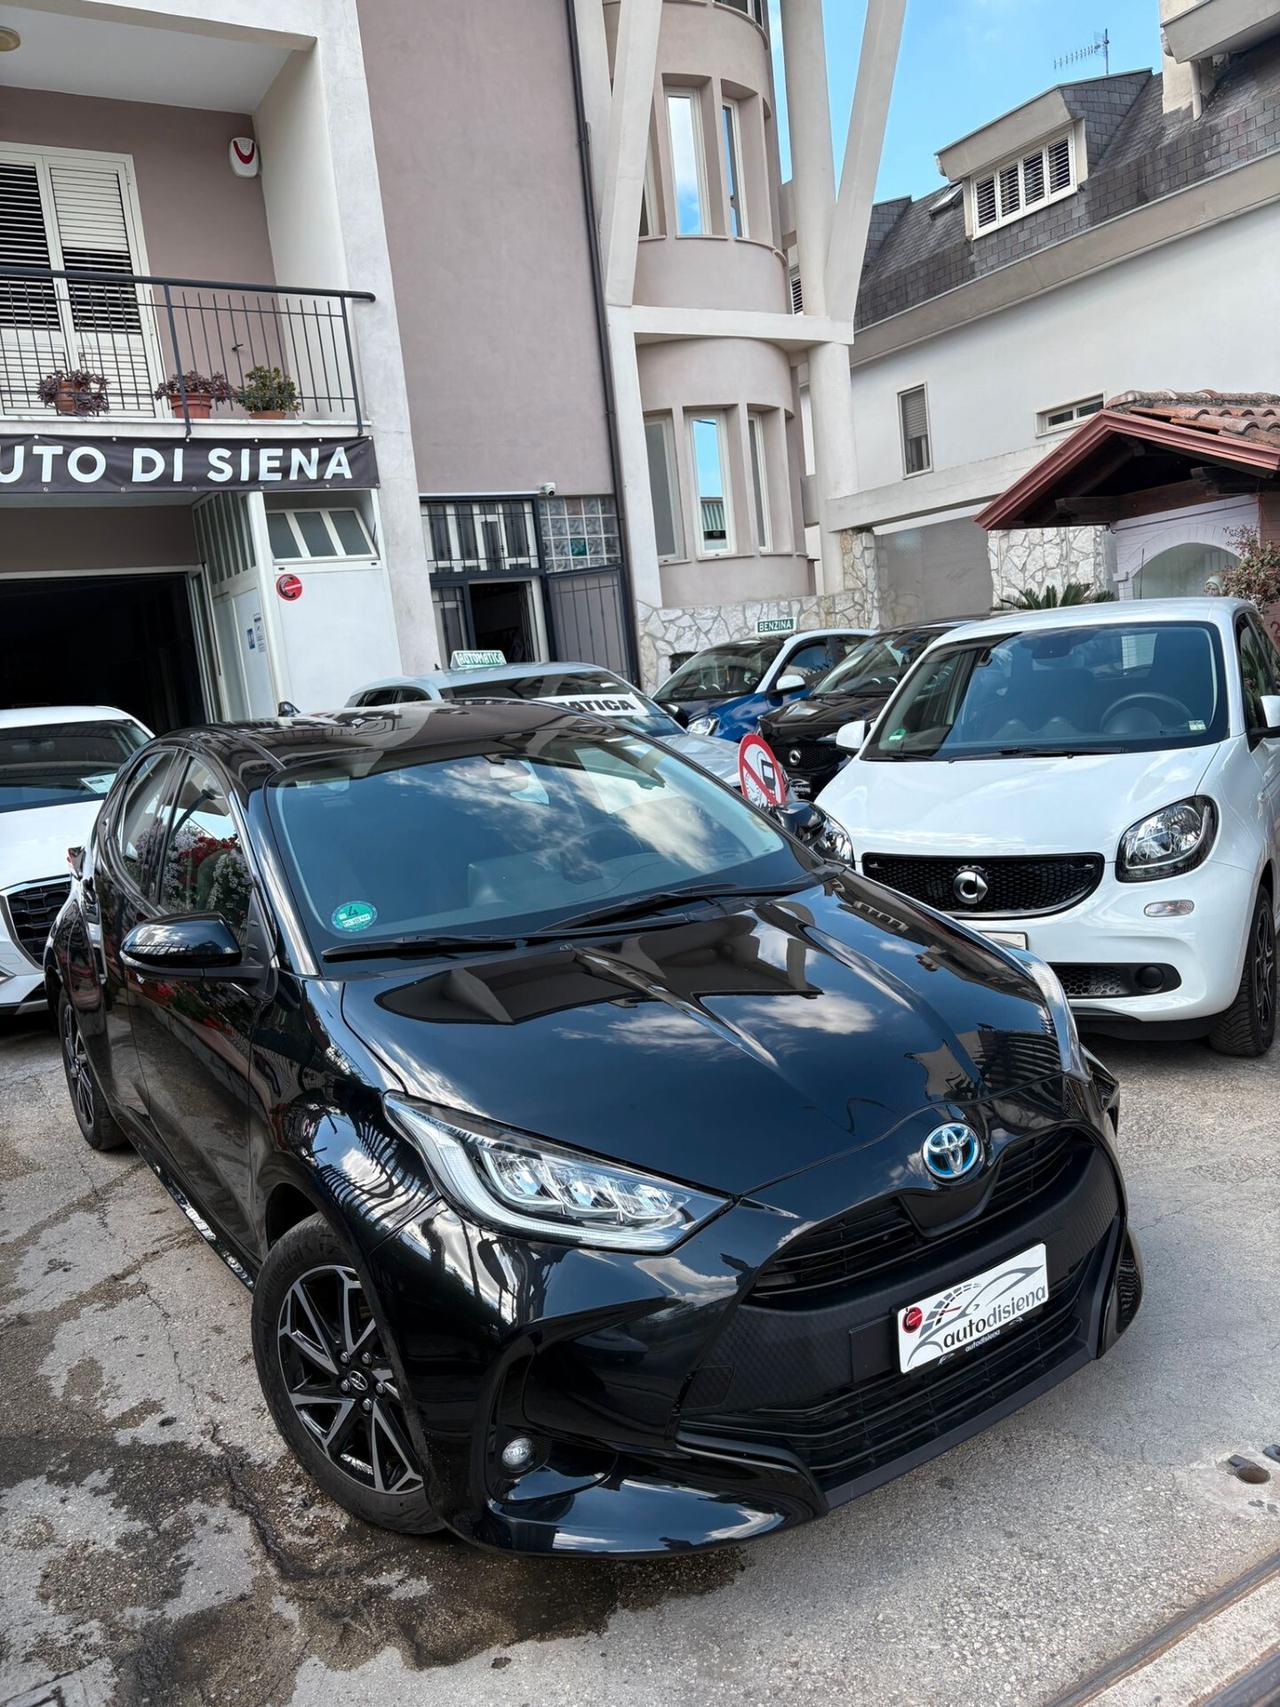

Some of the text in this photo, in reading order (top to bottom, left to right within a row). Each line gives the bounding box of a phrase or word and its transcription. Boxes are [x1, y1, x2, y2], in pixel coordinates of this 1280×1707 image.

[131, 447, 184, 483] DI
[207, 446, 353, 482] SIENA
[758, 620, 792, 632] BENZINA
[943, 1285, 1046, 1348] autodisiena
